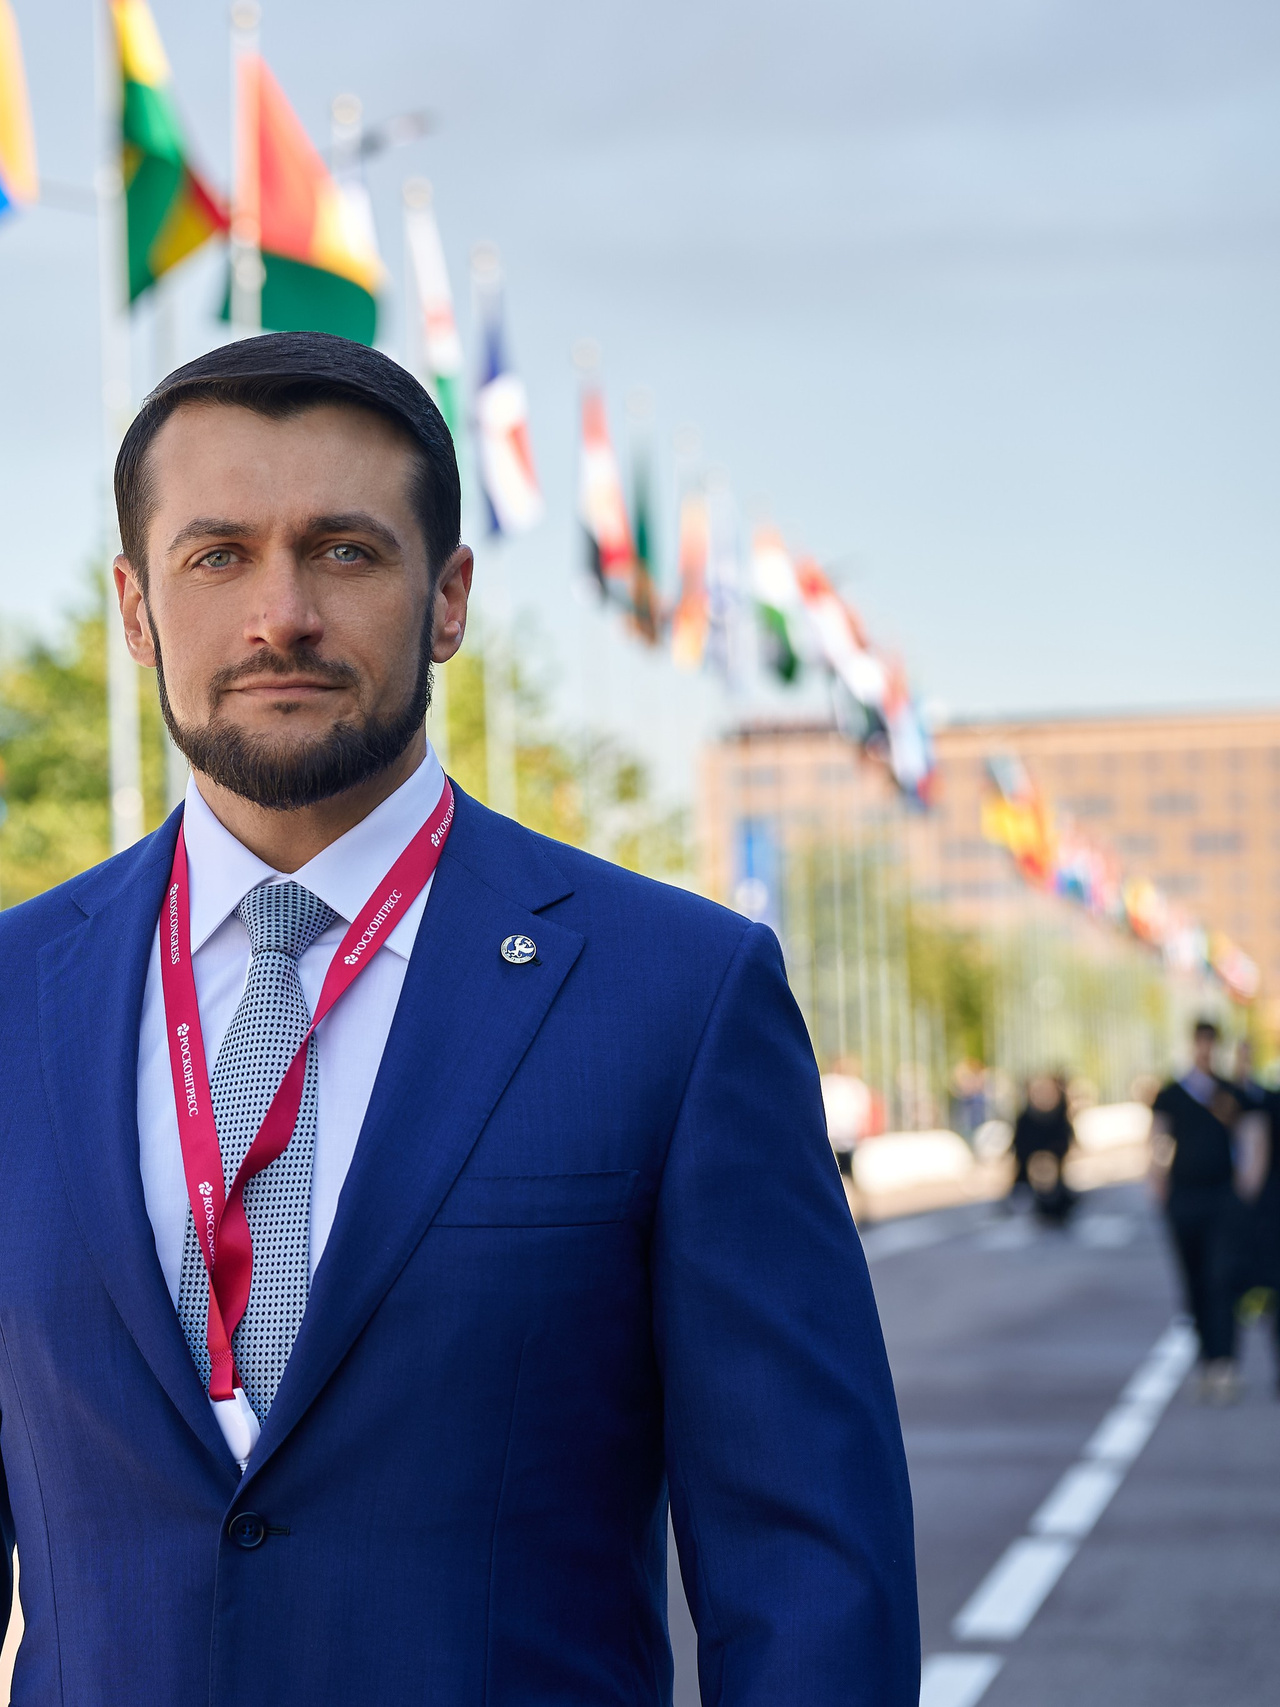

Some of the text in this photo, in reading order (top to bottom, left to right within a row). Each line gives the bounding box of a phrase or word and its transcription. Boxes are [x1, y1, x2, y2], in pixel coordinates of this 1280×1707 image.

[170, 894, 181, 964] ROSCONGRESS
[352, 889, 402, 955] РОСКОНГРЕСС
[180, 1036, 198, 1117] РОСКОНГРЕСС
